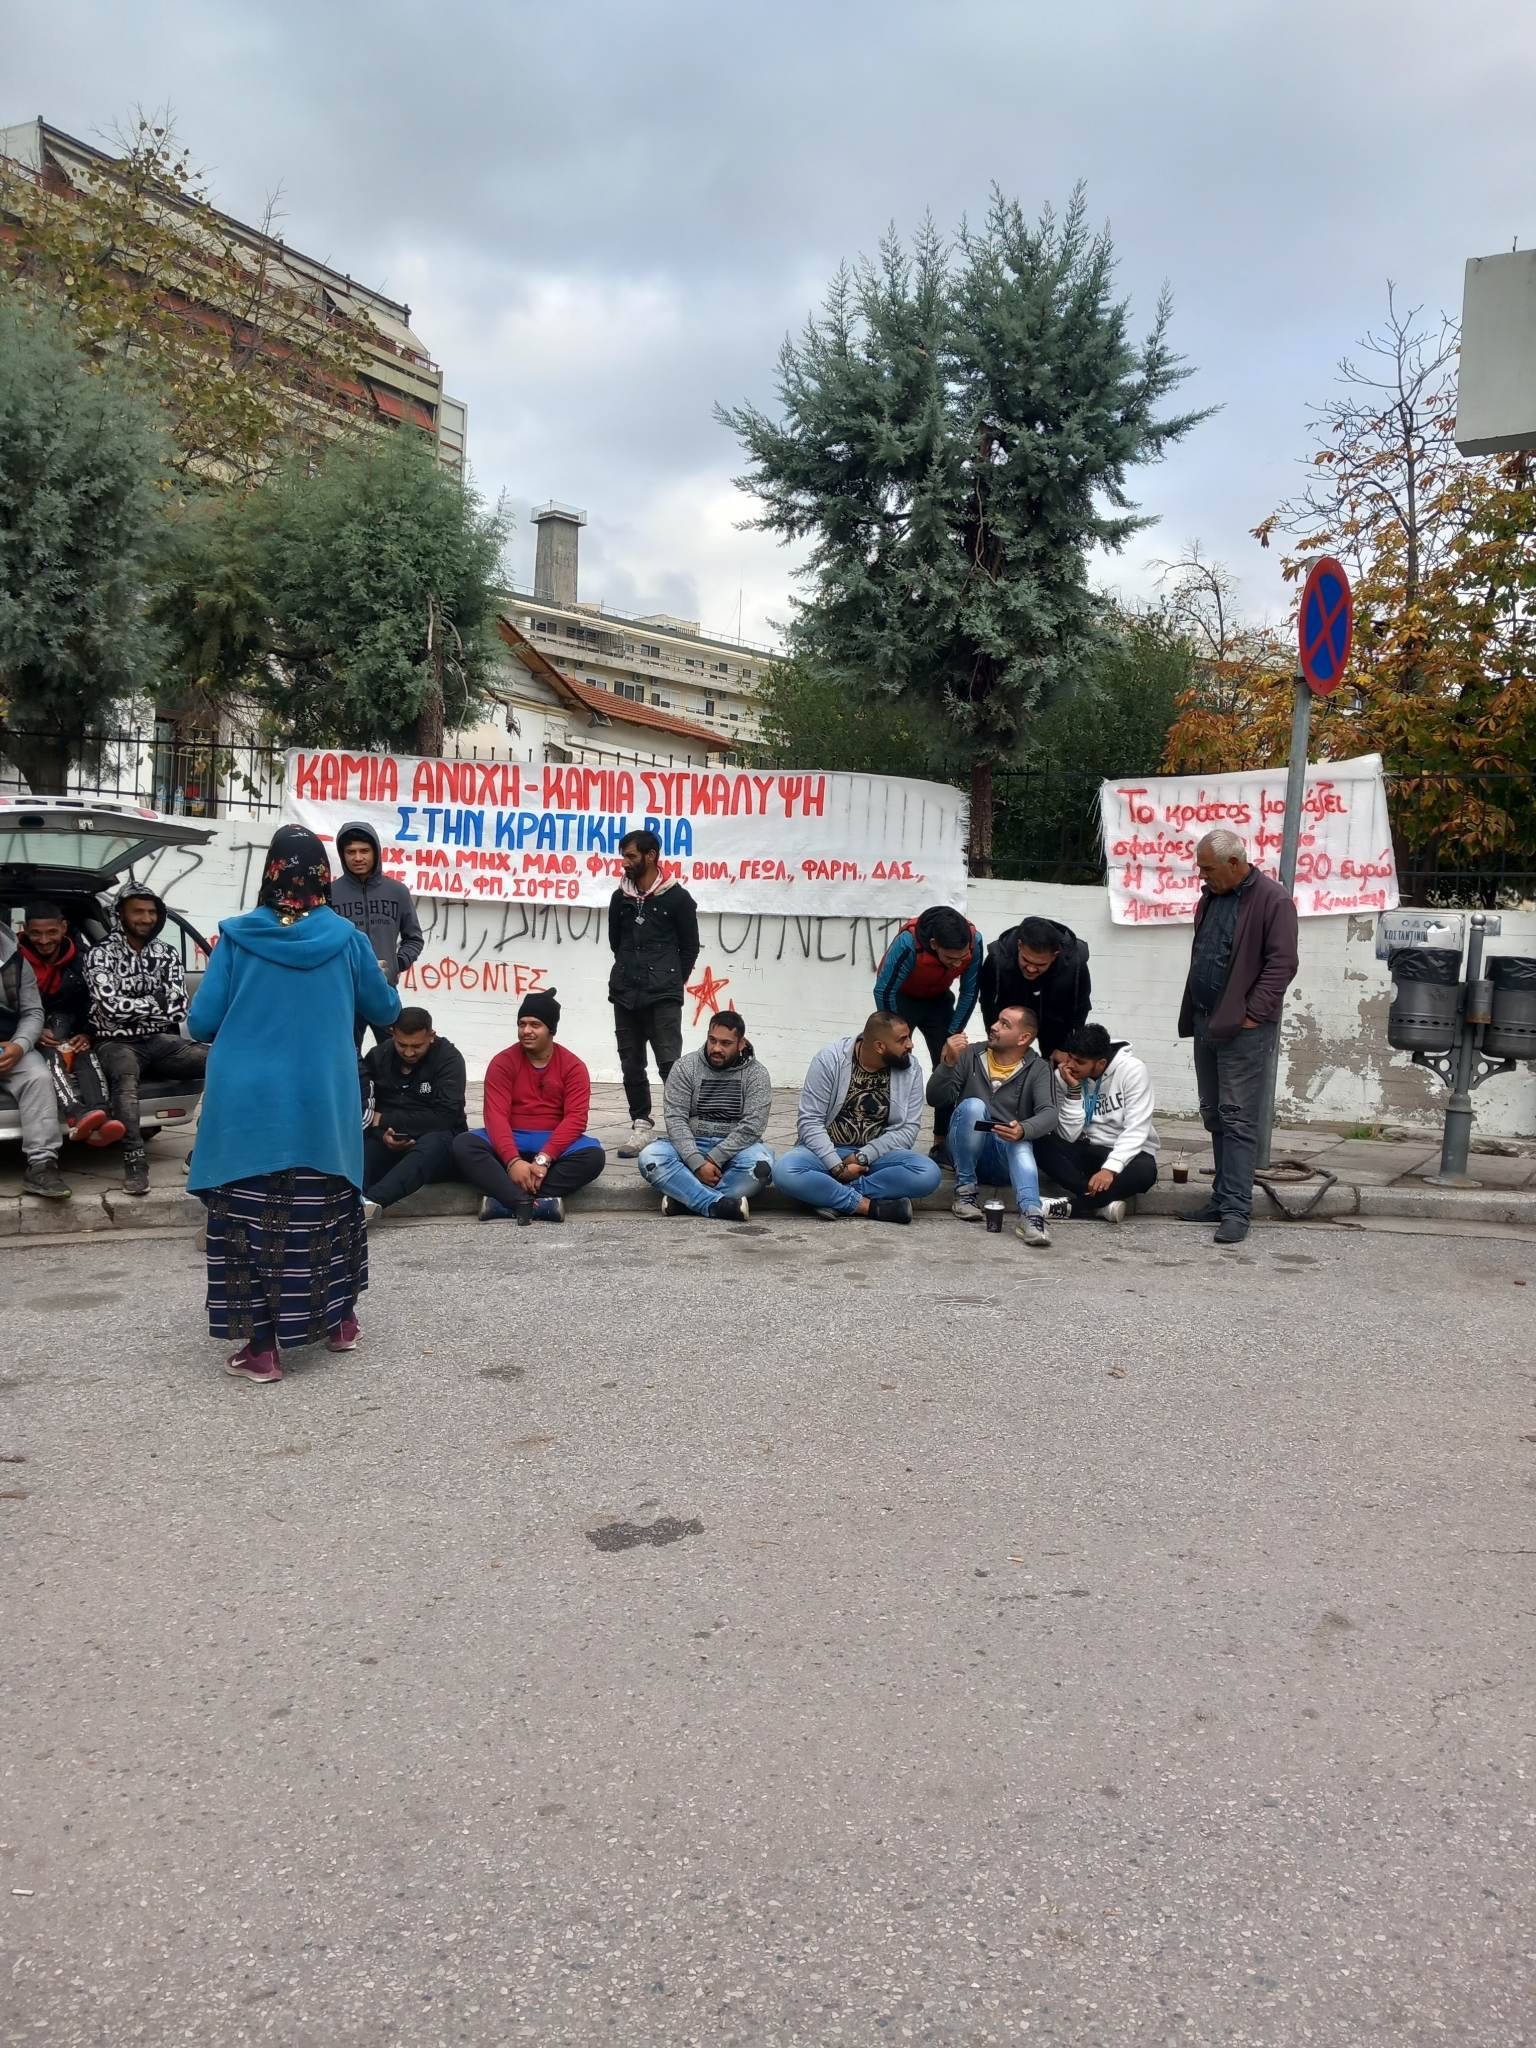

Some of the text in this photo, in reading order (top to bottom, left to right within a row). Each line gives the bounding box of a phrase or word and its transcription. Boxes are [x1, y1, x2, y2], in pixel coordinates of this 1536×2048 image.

[296, 753, 398, 801] ΚΑΜΙΑ
[640, 770, 826, 818] ΣΥΓΚΑΛΥΨΗ
[395, 807, 485, 848] ΣΤΗΝ
[496, 811, 627, 854] ΚΡΑΤΙΚΗ
[1117, 788, 1155, 824] Το
[1165, 790, 1252, 833] κράτος
[456, 850, 517, 876] ΜΗΧ,
[1112, 831, 1195, 863] σφαίρες
[473, 875, 509, 899] ΦΠ,
[512, 877, 580, 900] ΣΟΦΕΘ
[1123, 862, 1143, 889] Η
[1340, 848, 1393, 892] ευρώ
